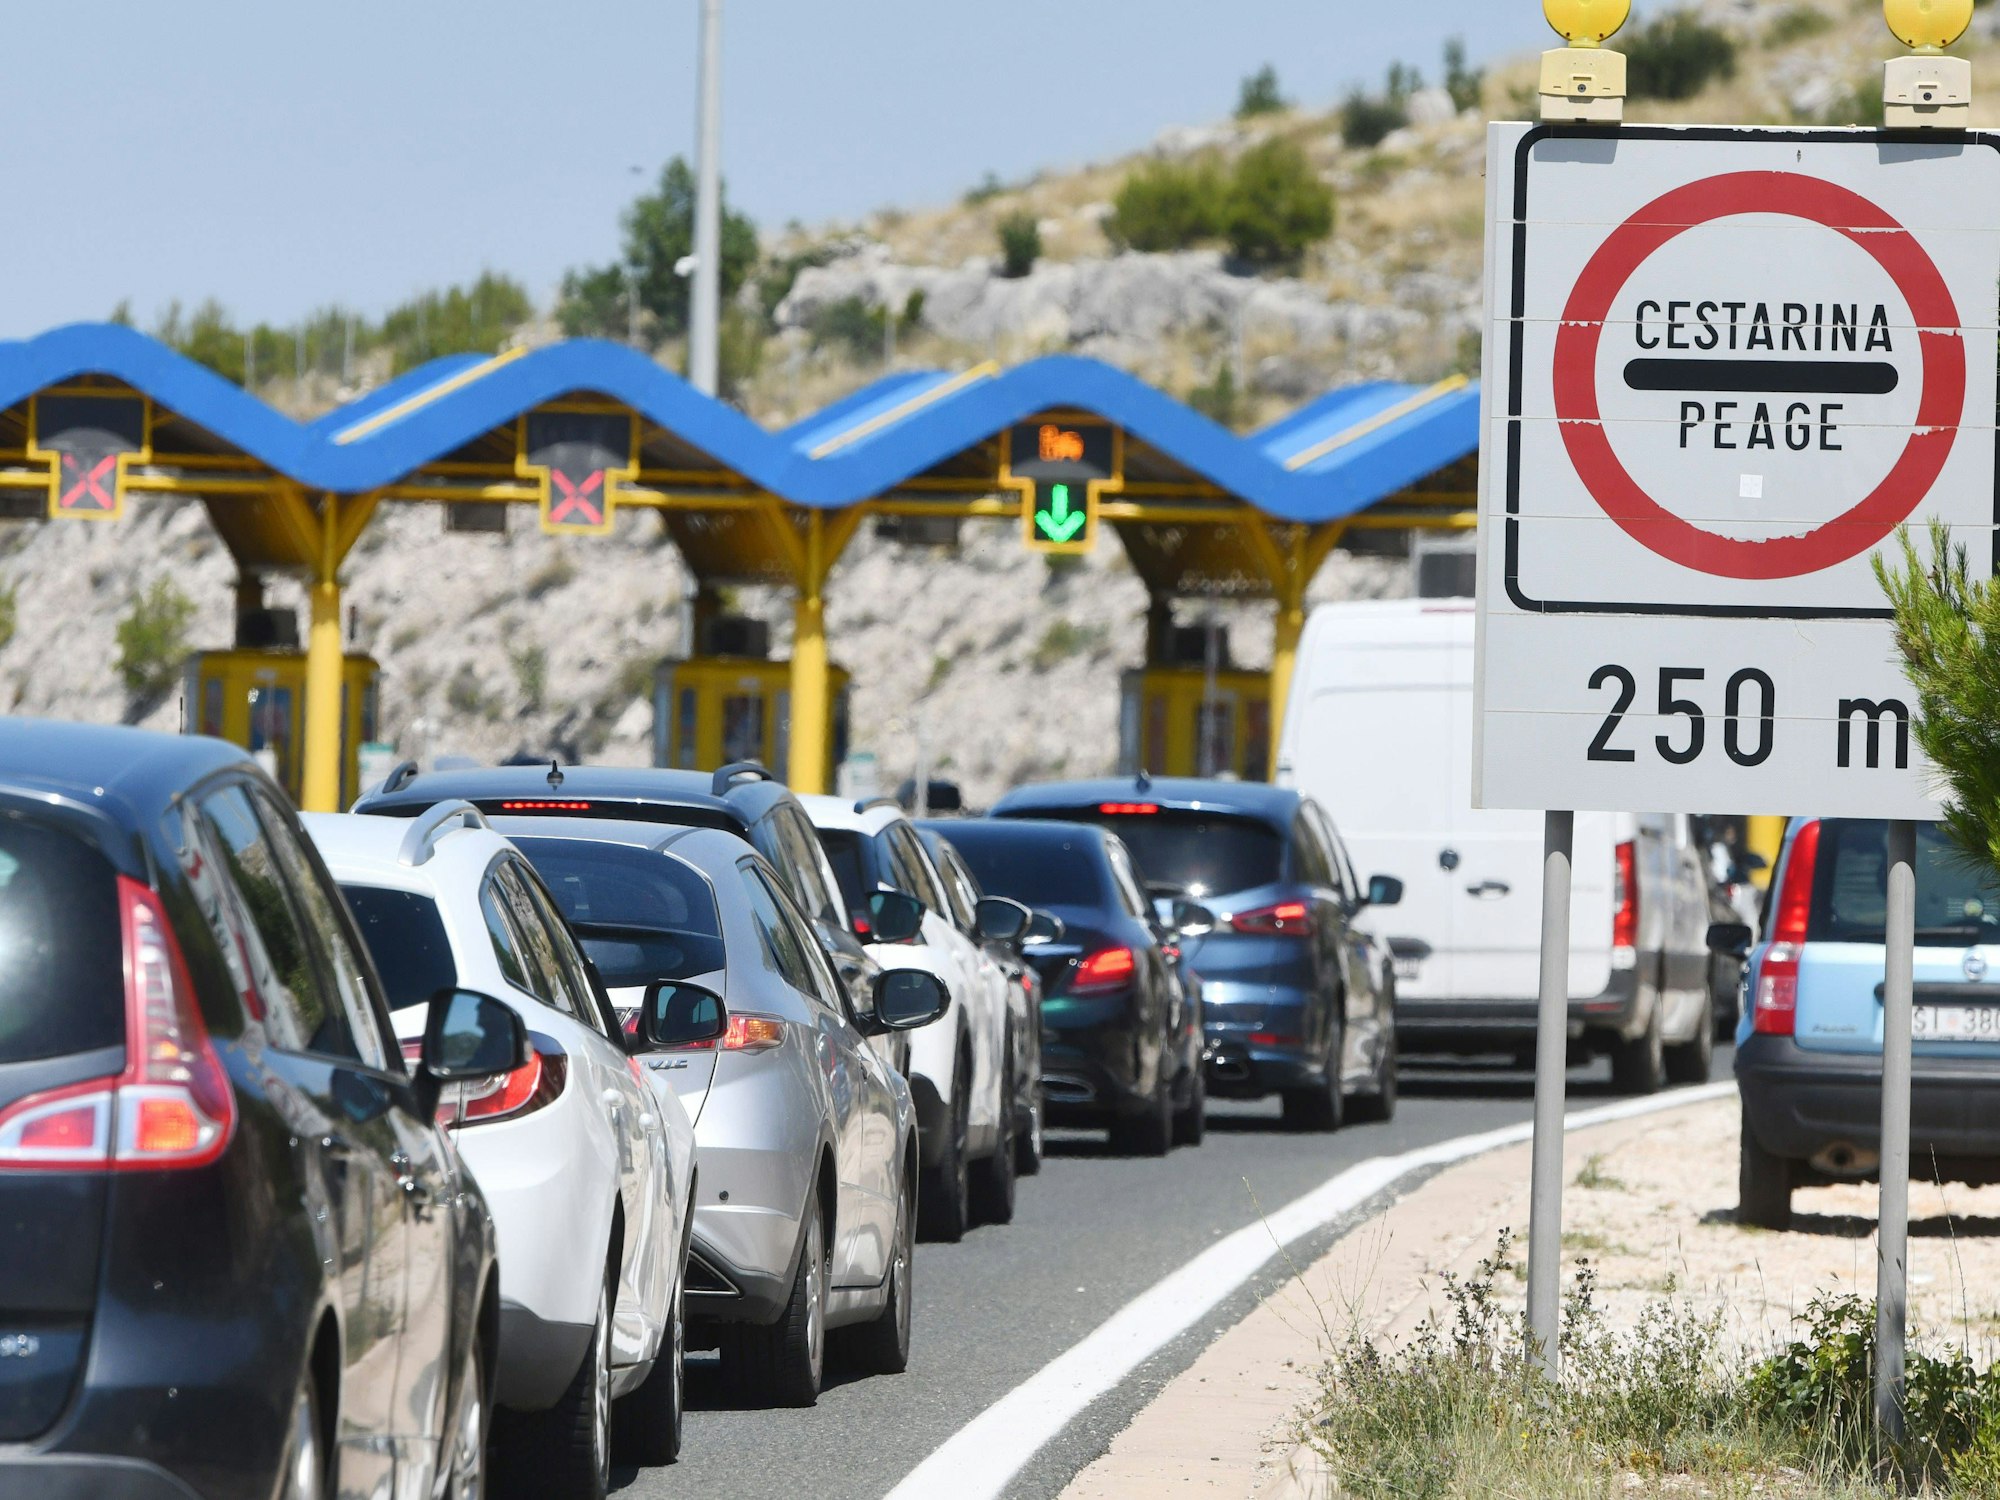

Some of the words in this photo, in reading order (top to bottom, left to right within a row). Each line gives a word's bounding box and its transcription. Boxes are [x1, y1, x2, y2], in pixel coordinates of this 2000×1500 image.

[1635, 300, 1893, 352] CESTARINA
[1679, 401, 1844, 451] PEAGE
[1587, 664, 1775, 767] 250
[1837, 698, 1909, 769] m
